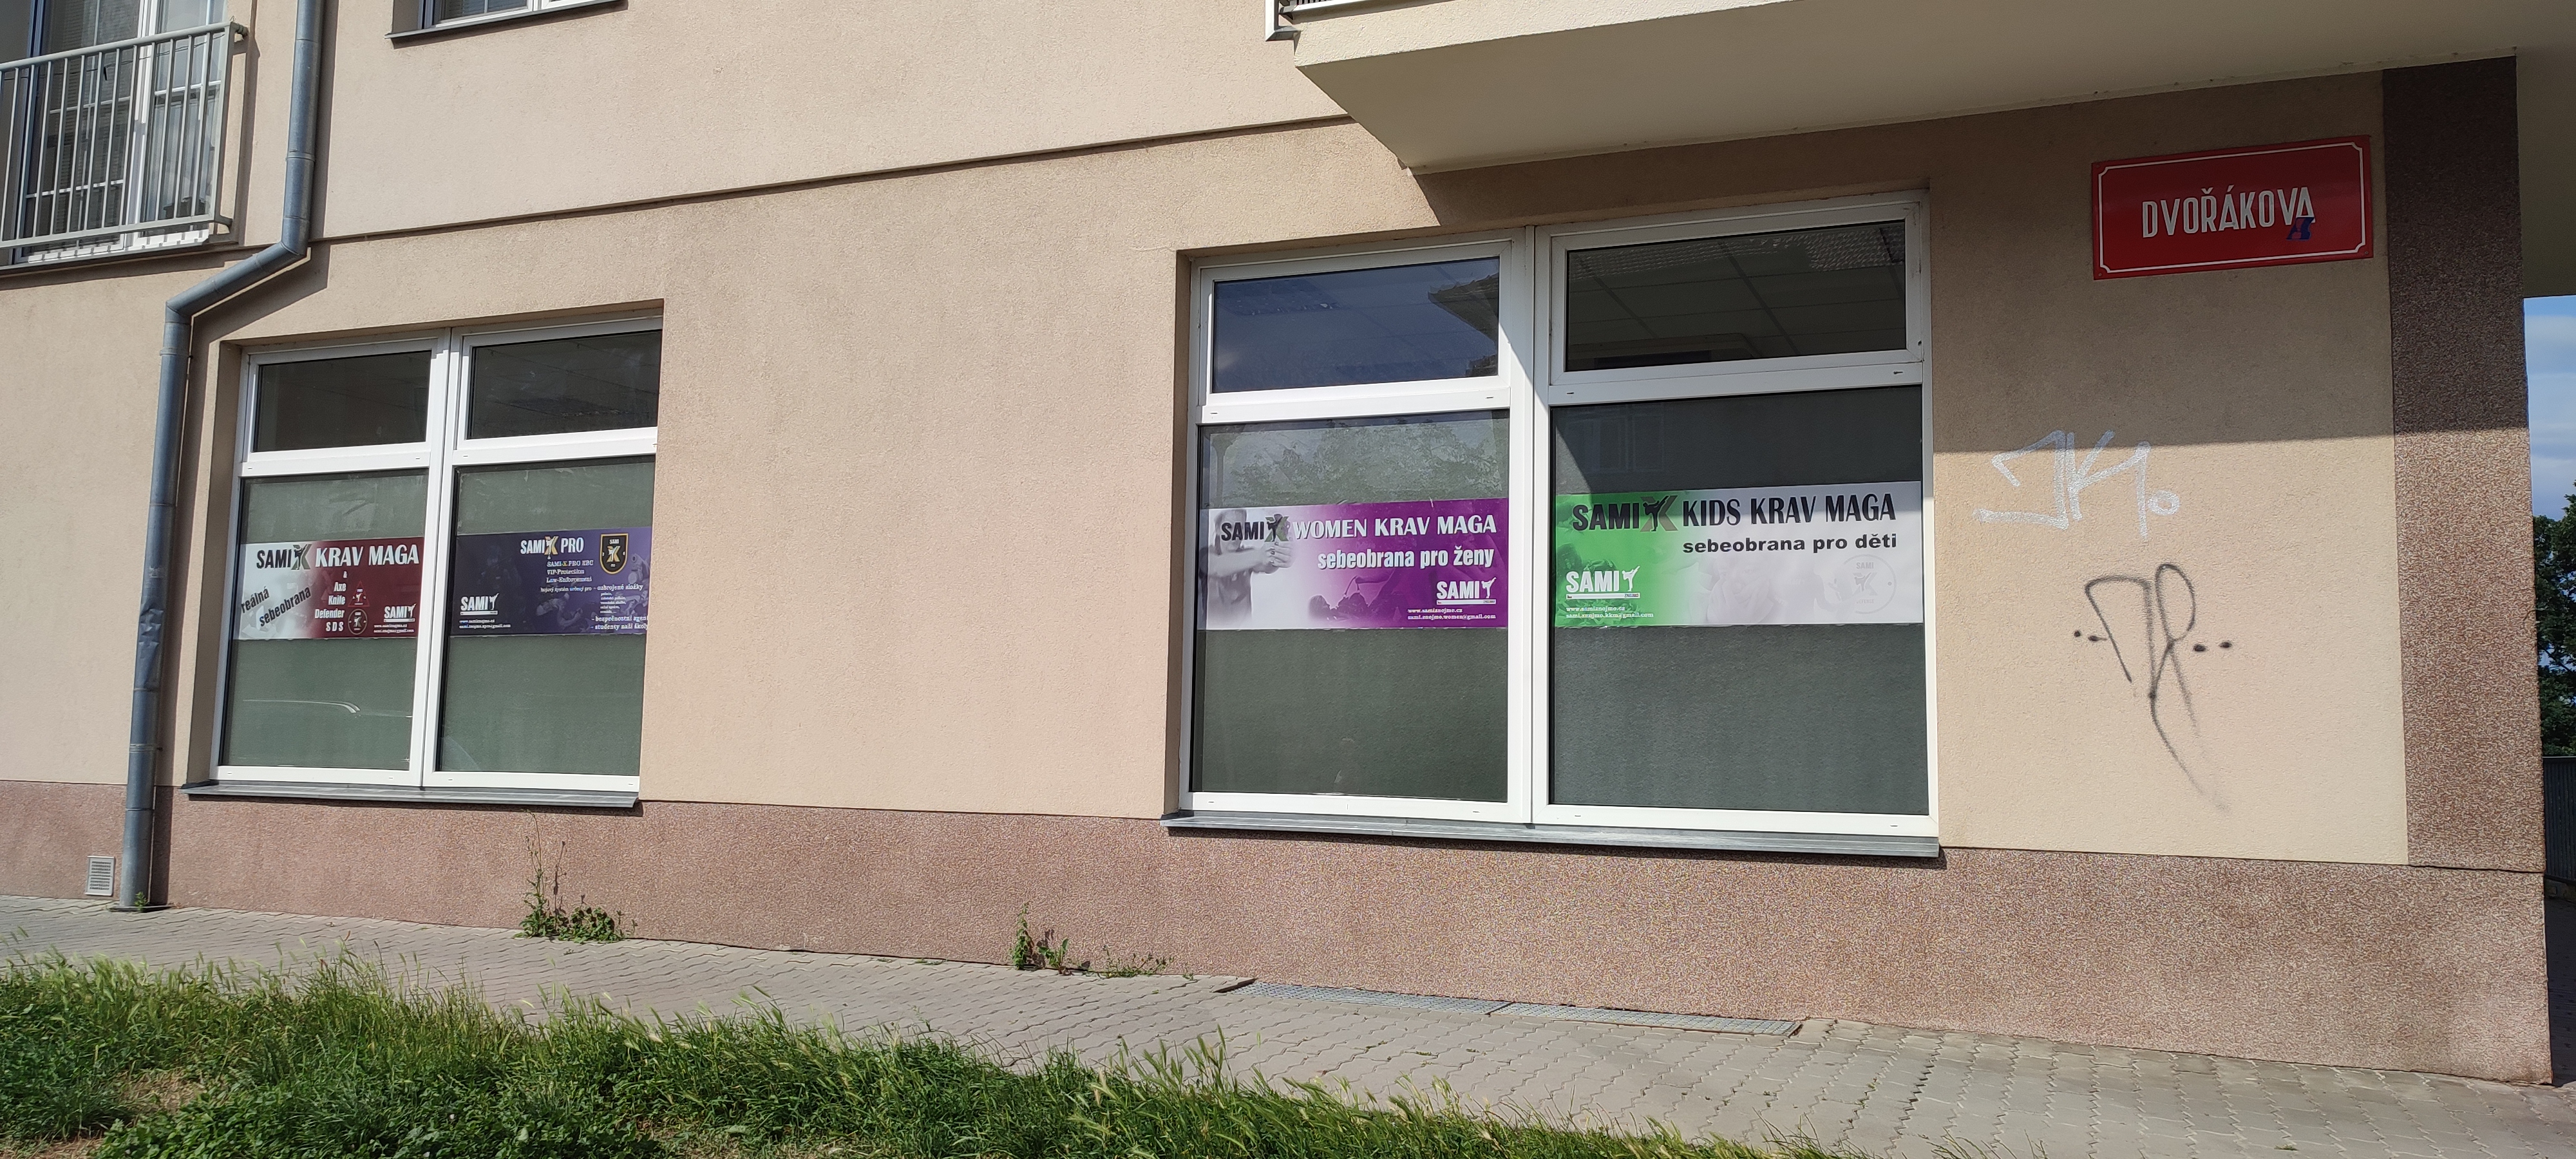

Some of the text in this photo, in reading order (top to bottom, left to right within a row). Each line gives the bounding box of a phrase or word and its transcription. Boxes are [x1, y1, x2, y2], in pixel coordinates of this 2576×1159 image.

[2142, 185, 2316, 238] DVOŘÁKOVA
[1682, 498, 1741, 527] KIDS
[1751, 495, 1817, 525] KRAV
[1825, 493, 1897, 522] MAGA
[1293, 518, 1368, 540] WOMEN
[1375, 516, 1432, 537] KRAV
[1437, 514, 1497, 536] MAGA
[561, 537, 584, 553] PRO
[1683, 532, 1897, 554] sebeobrana pro děti
[315, 546, 364, 568] KRAV
[368, 544, 419, 567] MAGA
[1318, 544, 1495, 569] sebeobrana pro ženy
[334, 581, 346, 592] Axe
[1436, 580, 1480, 599] SAMI
[1566, 570, 1619, 592] SAMI
[241, 585, 270, 613] reálná
[259, 587, 312, 627] sebeobrana
[328, 595, 346, 605] Knife
[460, 596, 489, 611] SAMI
[315, 608, 345, 619] Defender
[384, 606, 407, 619] SAMI
